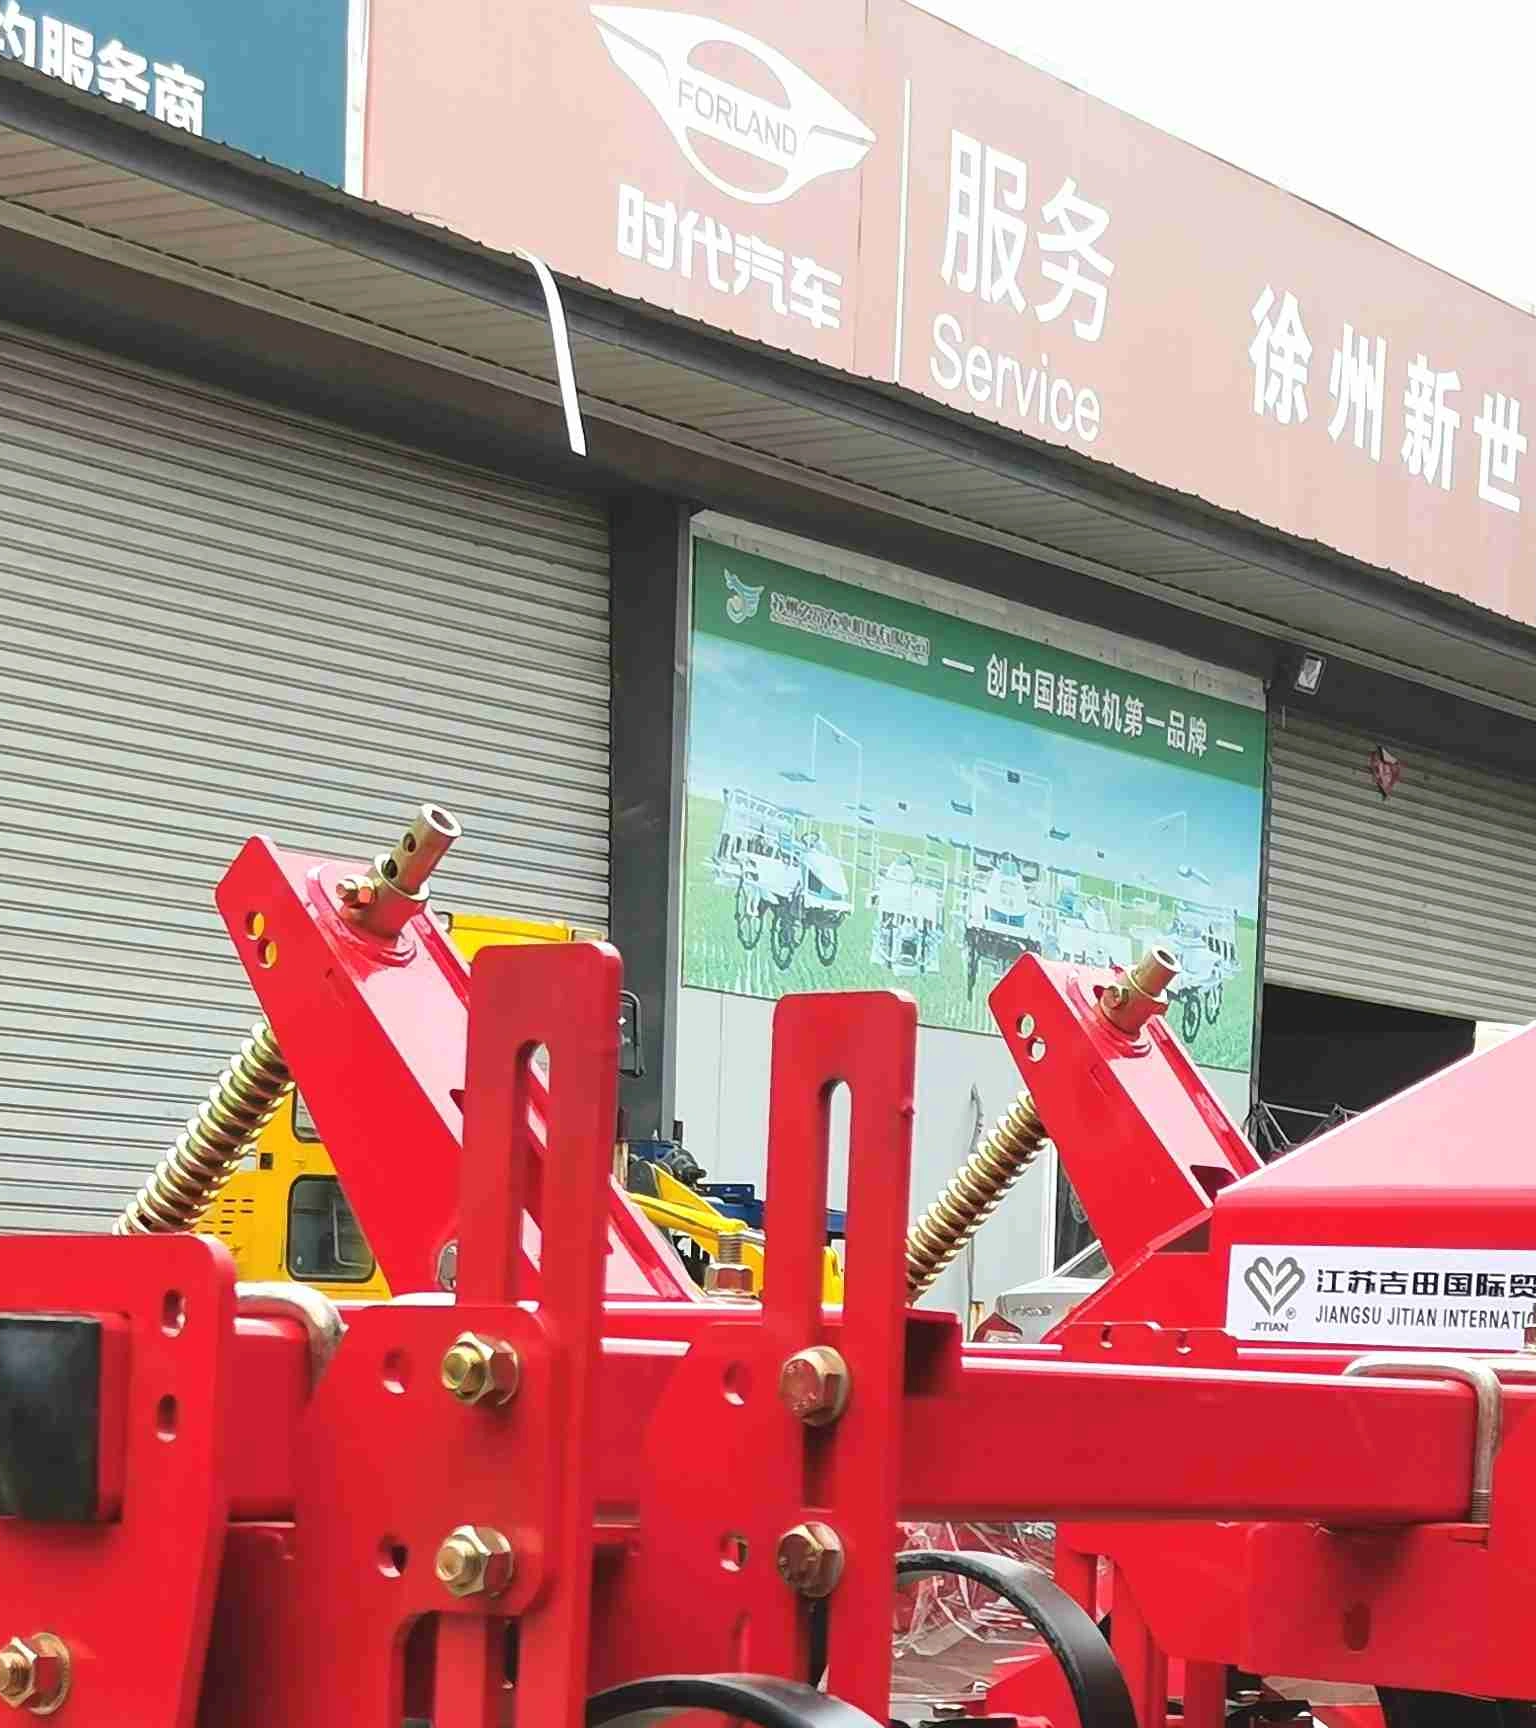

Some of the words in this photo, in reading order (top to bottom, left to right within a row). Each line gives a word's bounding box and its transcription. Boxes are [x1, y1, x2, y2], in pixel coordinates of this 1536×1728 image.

[677, 78, 798, 157] FORLAND
[616, 183, 845, 329] 时代汽车
[939, 128, 1115, 342] 服务
[930, 313, 1102, 442] Service
[986, 652, 1208, 757] 创中国插秧机第一品牌
[1248, 1320, 1289, 1333] JITIAN
[1314, 1304, 1382, 1326] JIANGSU
[1386, 1306, 1438, 1328] JITIAN
